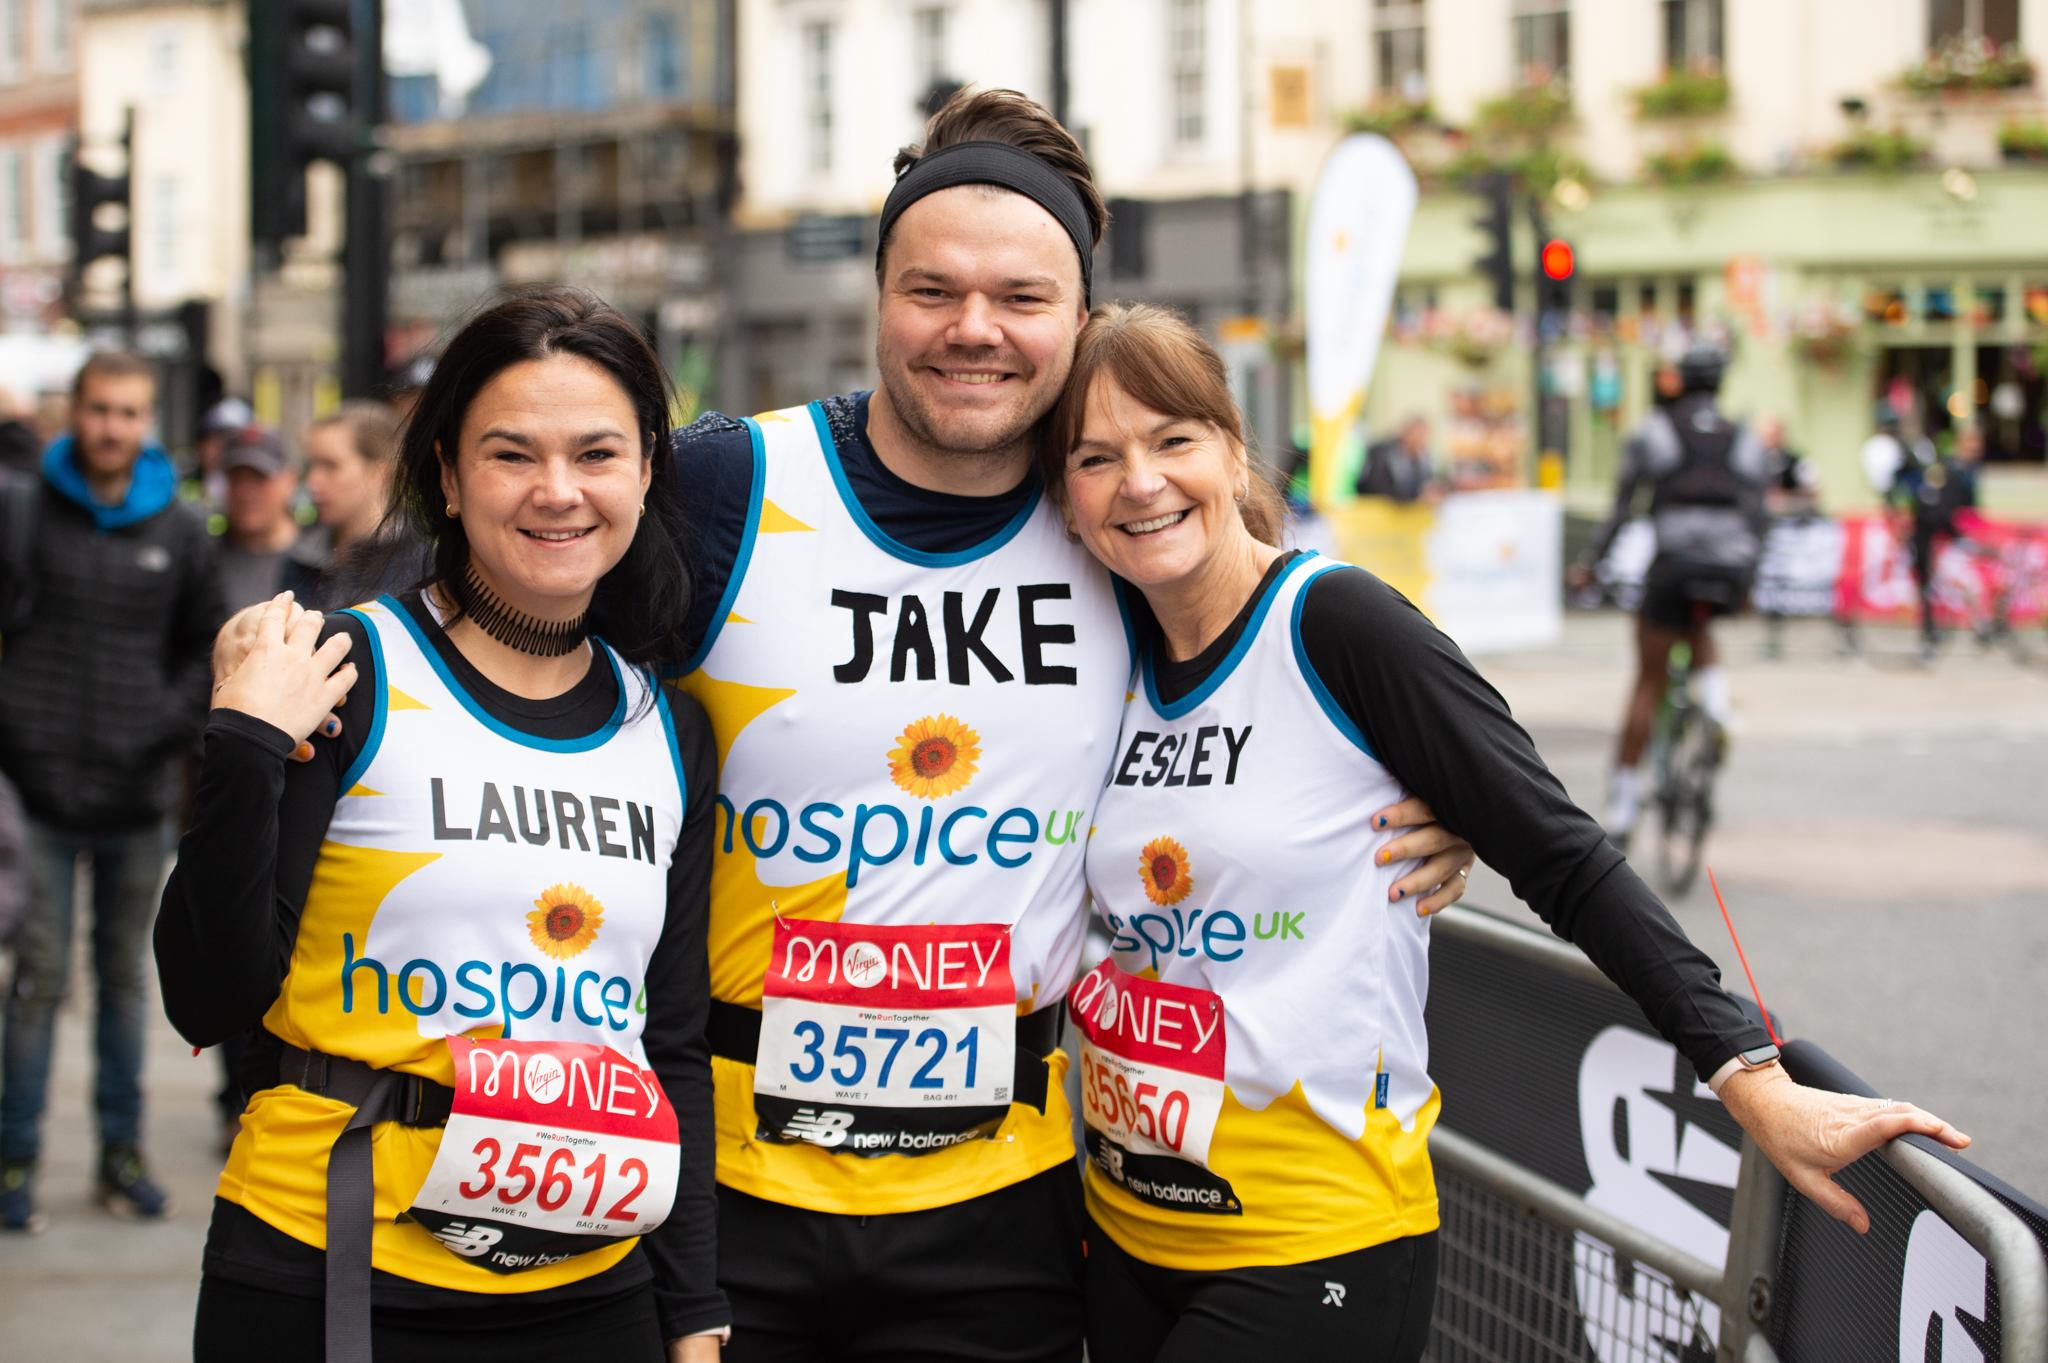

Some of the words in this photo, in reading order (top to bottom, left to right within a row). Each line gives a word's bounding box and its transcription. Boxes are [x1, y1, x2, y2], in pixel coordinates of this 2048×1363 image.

[831, 583, 1077, 686] JAKE
[1106, 725, 1252, 788] ESLEY
[430, 777, 656, 865] LAUREN
[1253, 911, 1306, 940] UK
[847, 949, 879, 980] Virgin
[341, 932, 632, 1039] hospice
[859, 1012, 930, 1023] #WeRunTogether
[789, 1020, 978, 1088] 35721
[528, 1060, 561, 1097] Virgin
[835, 1091, 860, 1099] WAVE
[923, 1094, 941, 1102] BAG
[1084, 1052, 1190, 1153] 35650
[536, 1131, 597, 1146] #WeRunTogether
[854, 1132, 895, 1149] new
[899, 1129, 979, 1149] balance
[459, 1138, 649, 1223] 35612
[1127, 1175, 1150, 1195] new
[1152, 1181, 1221, 1204] balance
[491, 1206, 516, 1216] WAVE
[576, 1220, 593, 1229] BAG
[491, 1251, 535, 1267] new
